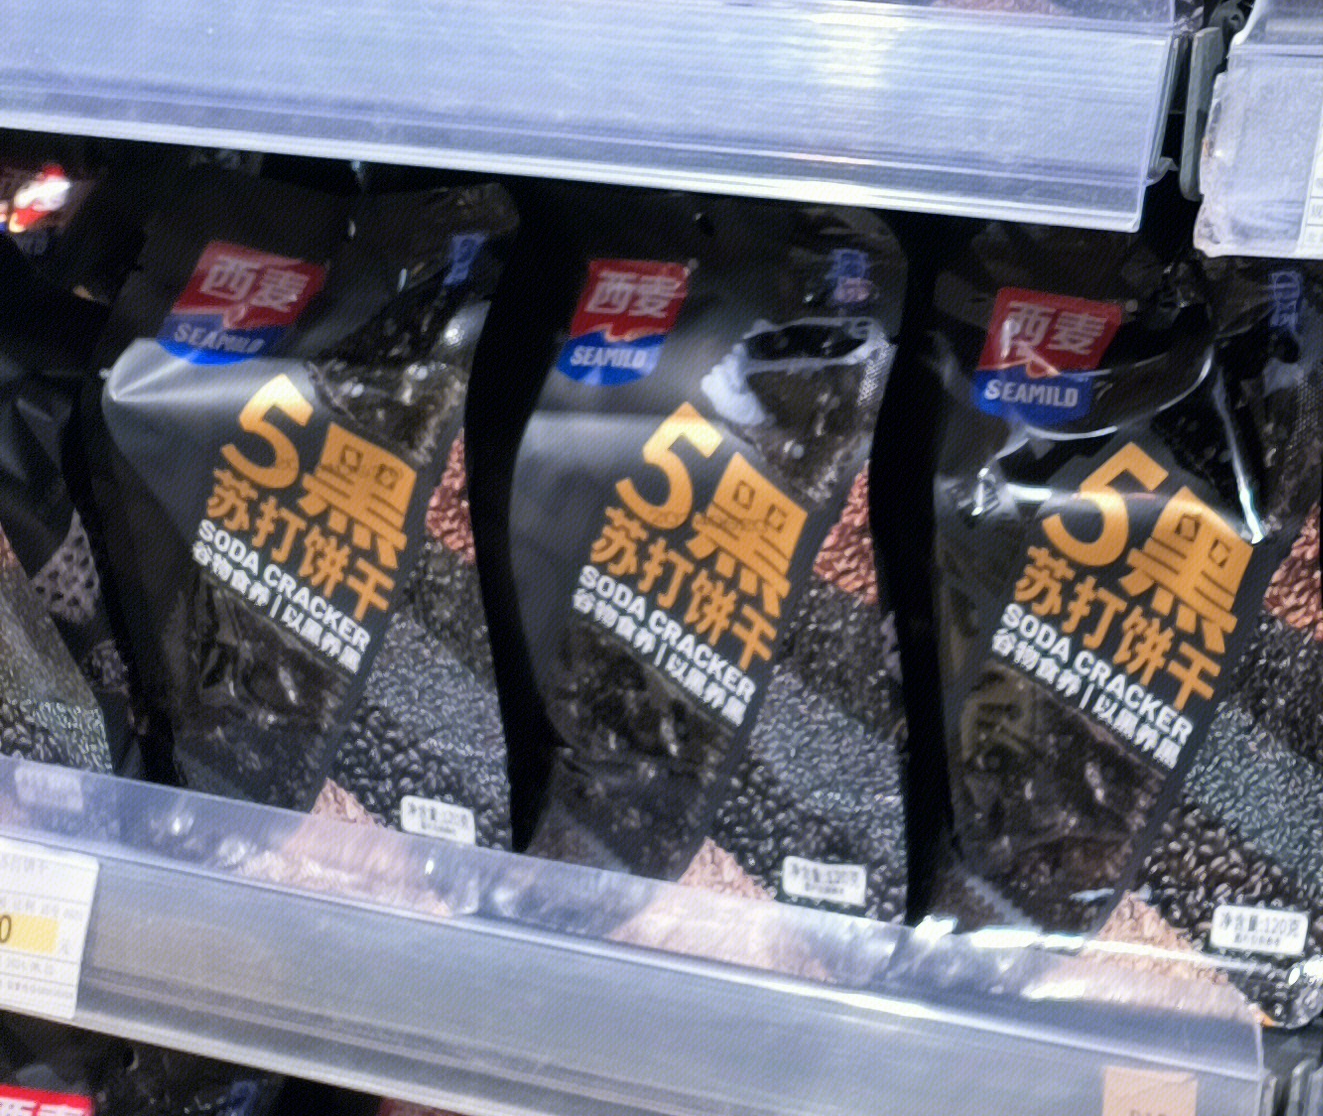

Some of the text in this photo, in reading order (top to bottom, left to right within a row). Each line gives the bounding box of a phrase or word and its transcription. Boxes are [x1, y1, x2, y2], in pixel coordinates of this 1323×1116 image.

[200, 255, 311, 312] 西麦
[585, 272, 681, 318] 西麦
[1001, 301, 1107, 357] 西麦
[570, 346, 647, 370] SEAMILD
[983, 378, 1078, 409] SEAMILD
[198, 518, 371, 653] SODA CRACKER
[205, 467, 396, 622] 苏打饼干
[590, 505, 778, 670] 苏打饼干
[578, 565, 756, 703] SODA CRACKER
[1002, 603, 1193, 742] SODA CRACKER
[1015, 545, 1222, 711] 苏打饼干
